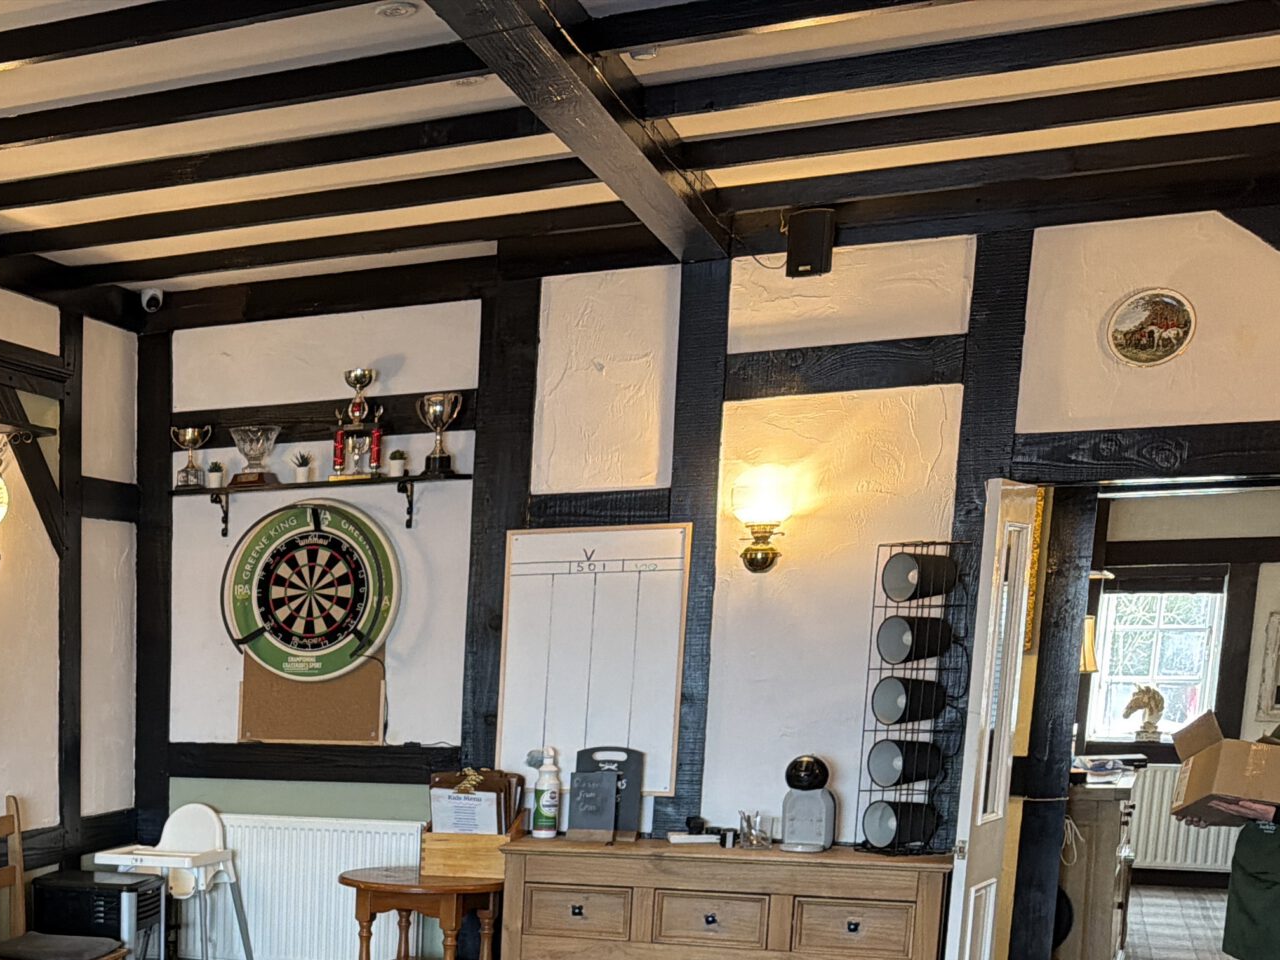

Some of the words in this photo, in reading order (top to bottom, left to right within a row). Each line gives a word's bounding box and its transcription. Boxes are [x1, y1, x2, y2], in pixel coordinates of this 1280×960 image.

[242, 536, 270, 580] GREENE
[269, 516, 297, 537] KING
[583, 548, 596, 561] V
[577, 562, 606, 572] 501
[234, 584, 251, 596] IPA
